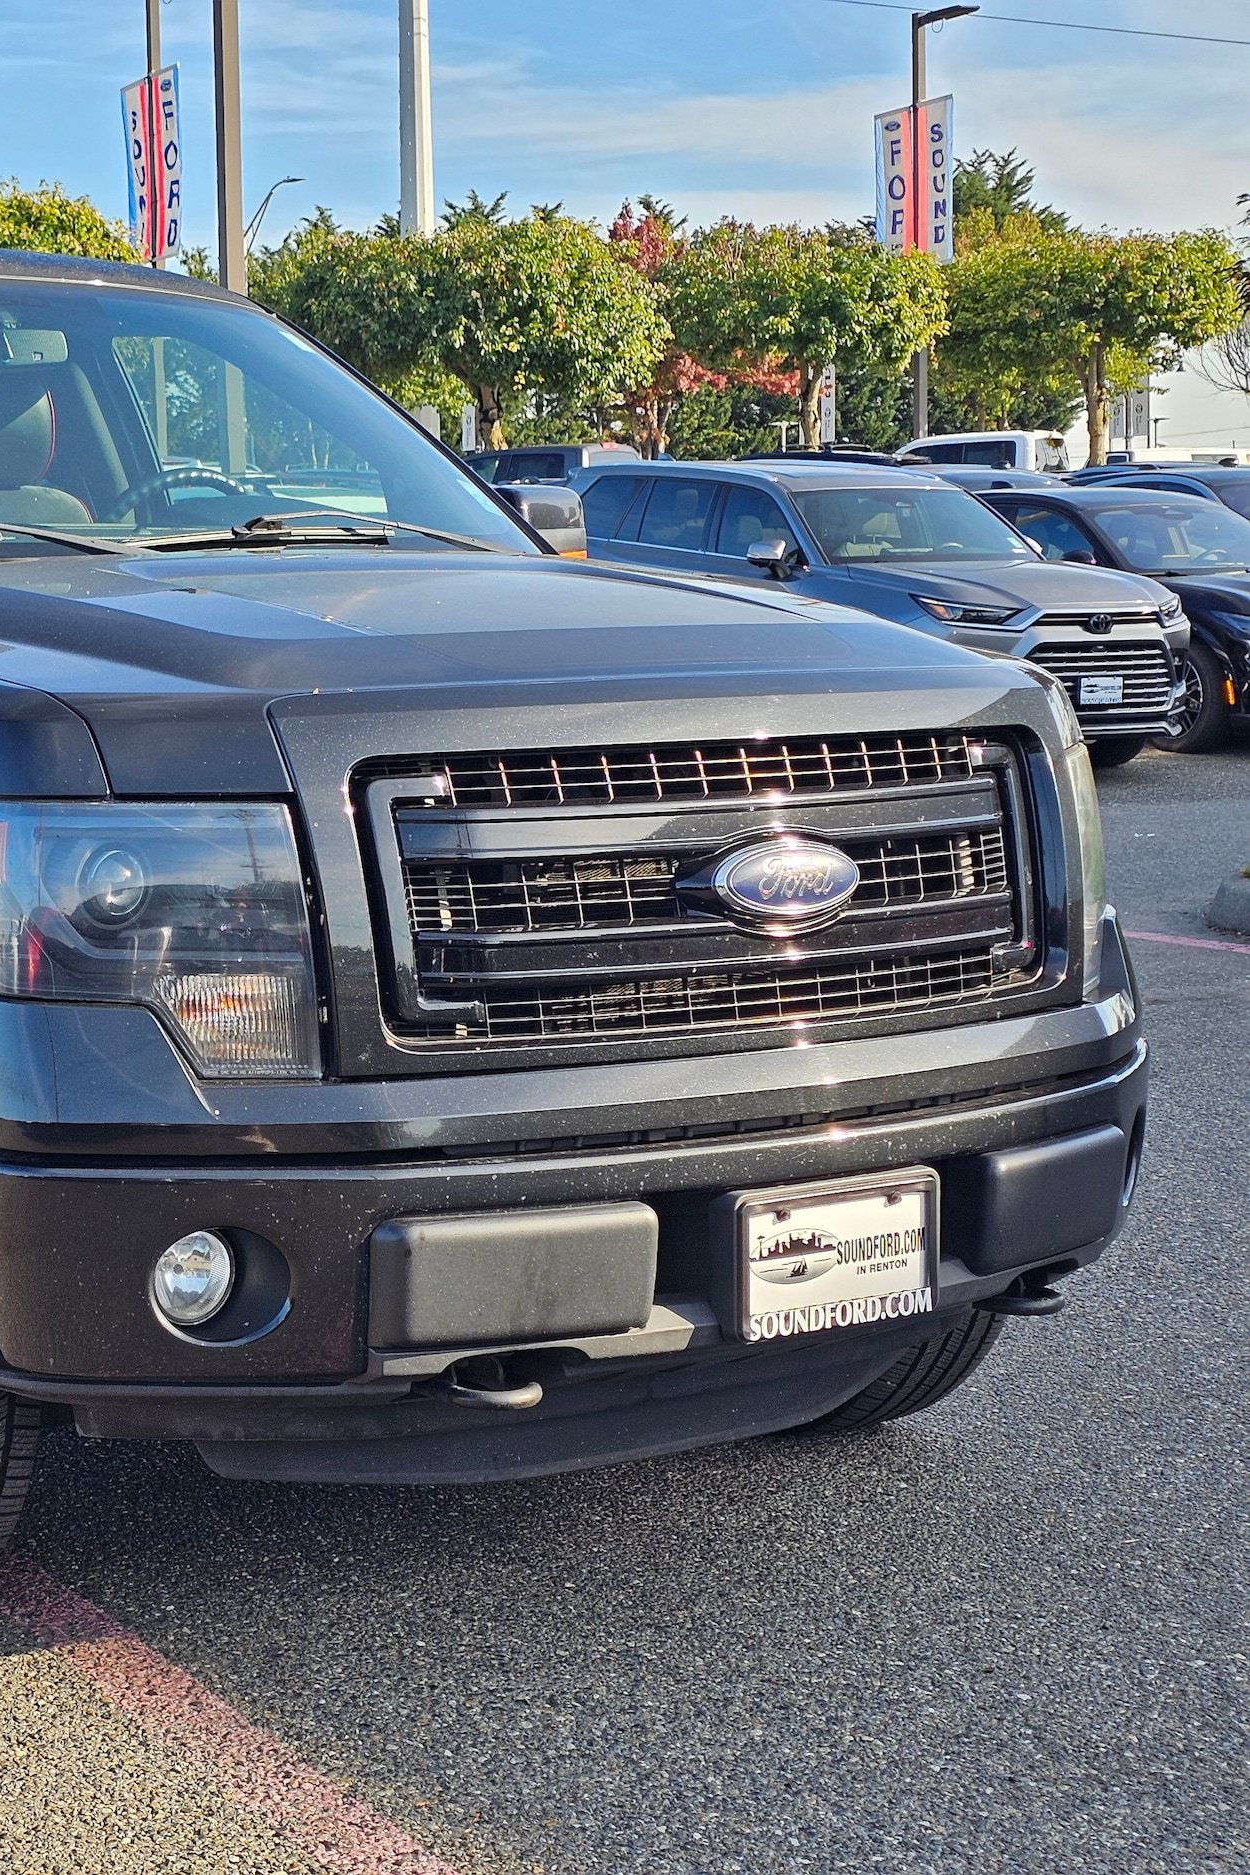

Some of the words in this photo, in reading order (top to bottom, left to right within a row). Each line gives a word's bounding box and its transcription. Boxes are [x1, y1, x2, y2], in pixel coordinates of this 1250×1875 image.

[162, 100, 180, 247] FORD
[930, 123, 947, 244] SOUND
[758, 856, 834, 900] Ford
[836, 1226, 926, 1265] SOUNDFORD.COM
[856, 1265, 866, 1275] IN
[869, 1258, 908, 1274] RENTON
[749, 1286, 933, 1342] SOUNDFORD.COM
